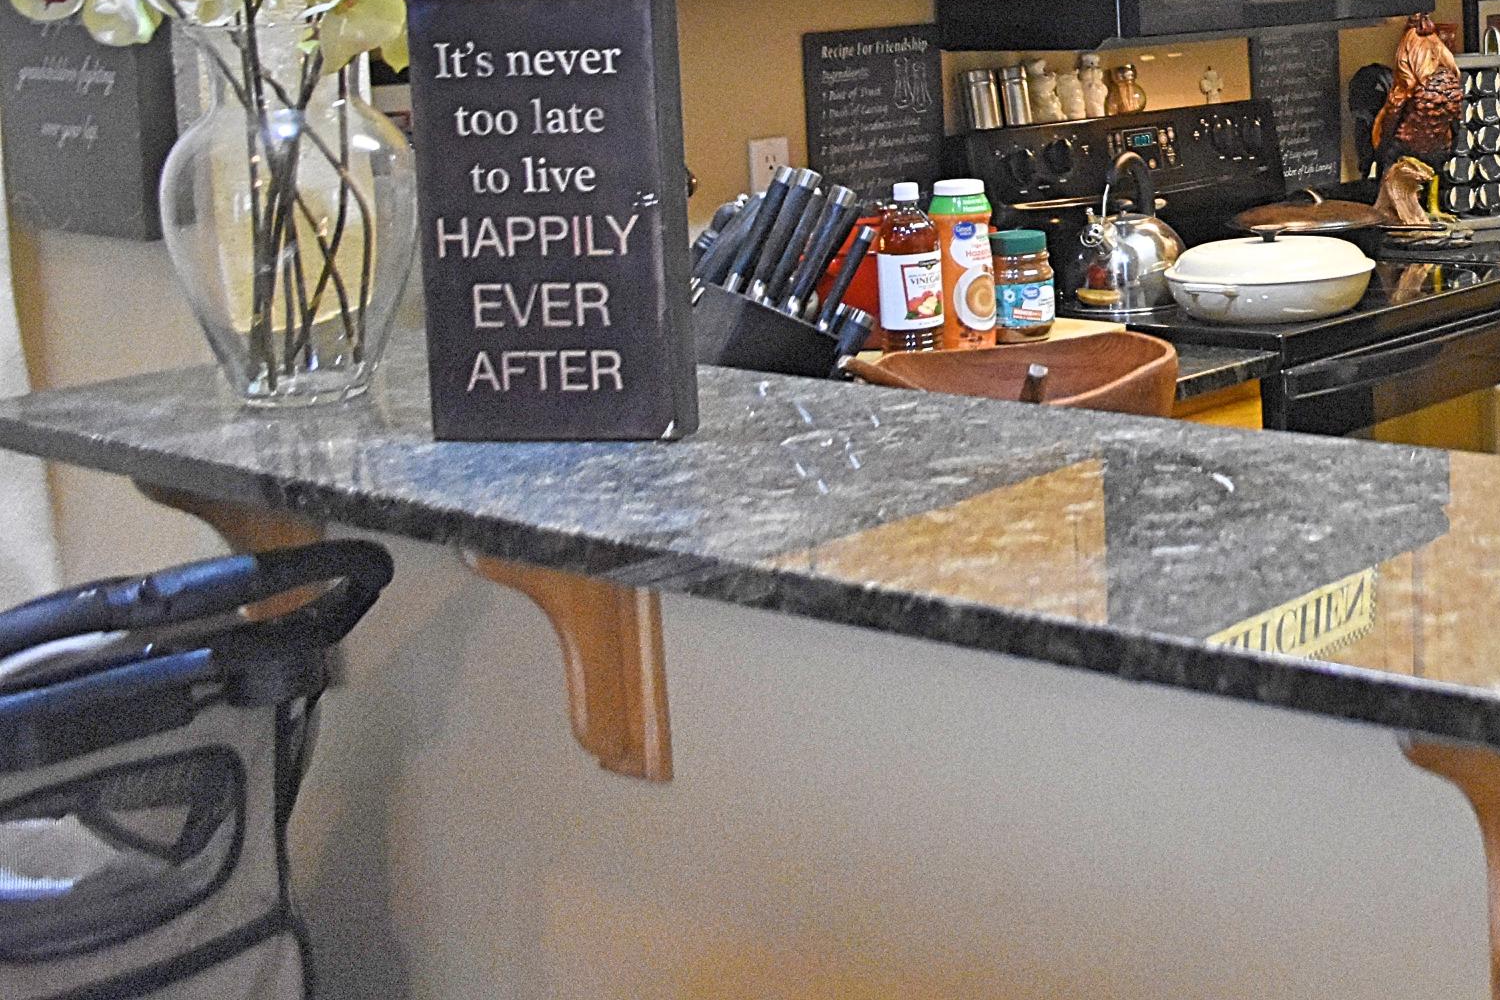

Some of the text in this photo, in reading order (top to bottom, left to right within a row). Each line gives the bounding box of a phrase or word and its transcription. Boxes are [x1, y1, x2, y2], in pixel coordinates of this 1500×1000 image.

[433, 41, 622, 79] It's never
[821, 45, 853, 60] Recipe
[876, 37, 928, 54] Friendship
[453, 98, 605, 136] too late
[470, 156, 596, 194] to live
[437, 214, 639, 260] HAPPILY
[910, 273, 940, 286] VINEGA
[473, 283, 611, 329] EVER
[467, 350, 623, 392] AFTER
